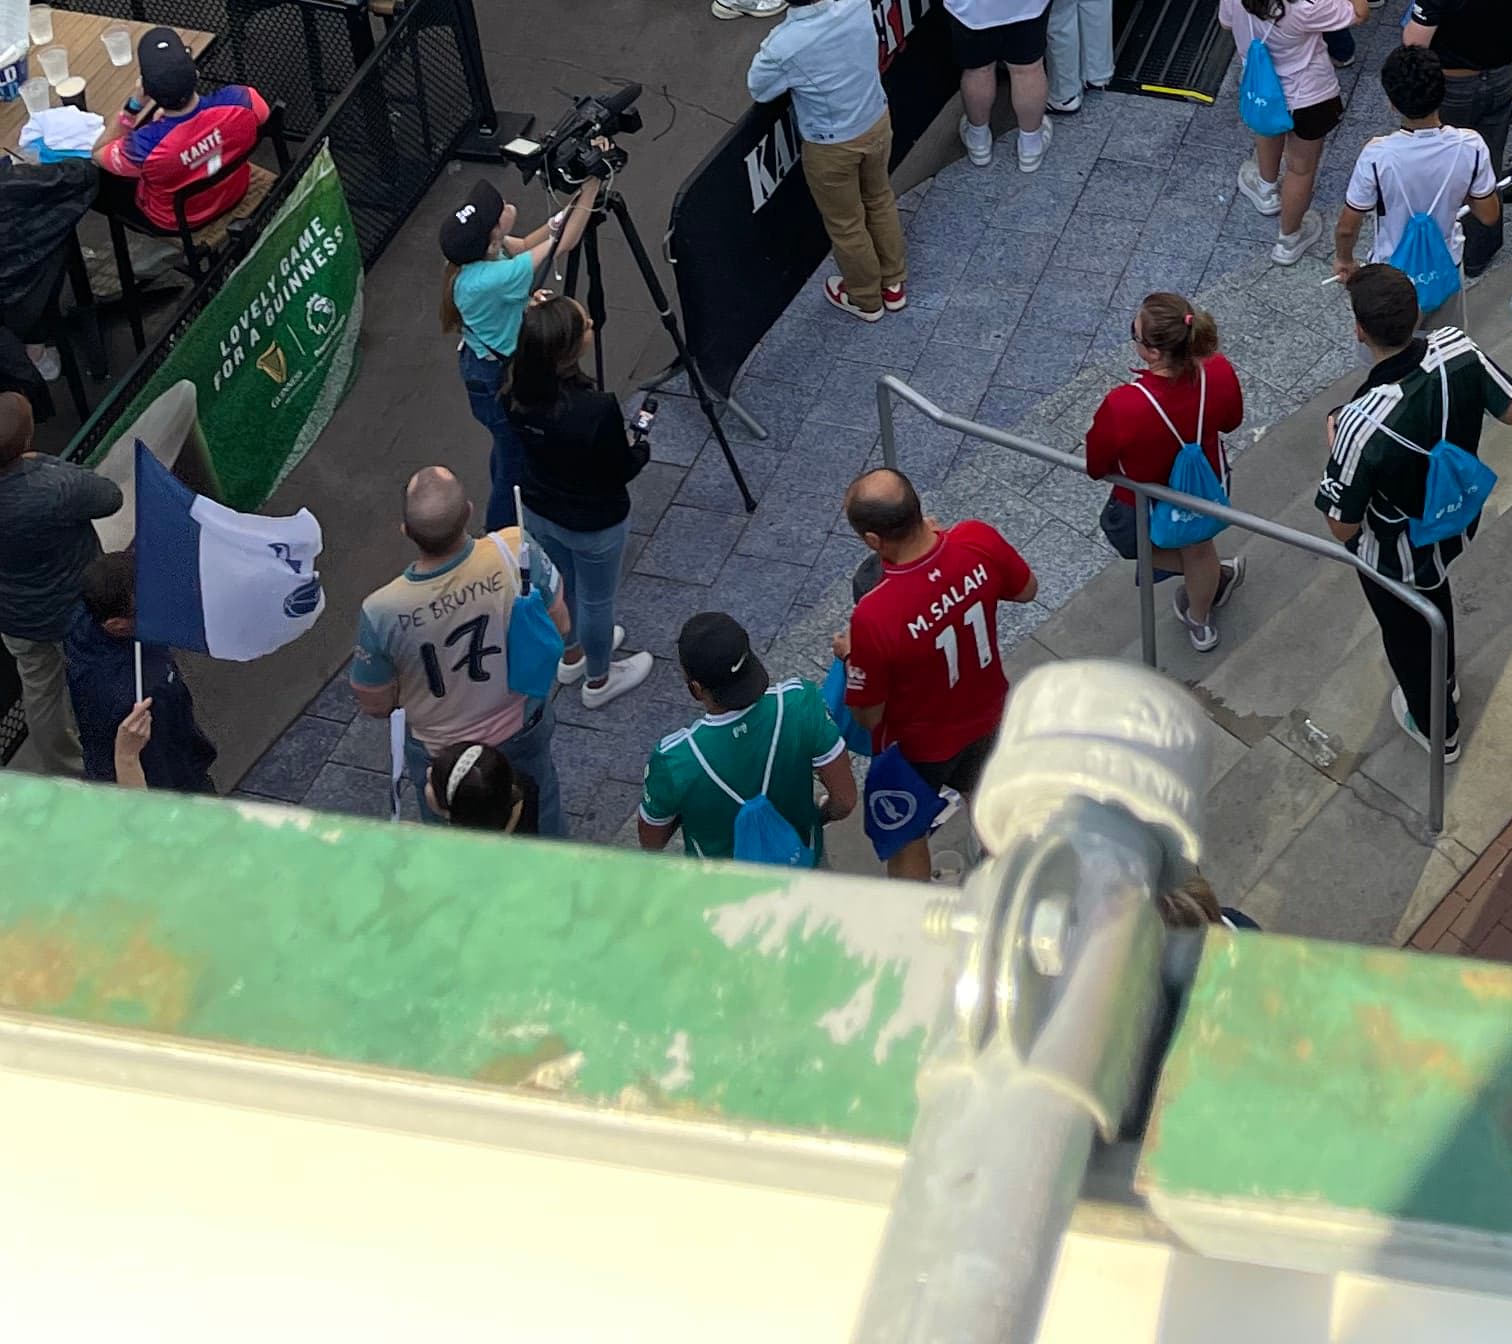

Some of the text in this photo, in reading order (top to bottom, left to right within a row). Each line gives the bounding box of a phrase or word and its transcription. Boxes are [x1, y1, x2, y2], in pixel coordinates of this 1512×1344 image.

[213, 345, 246, 392] FOR
[250, 327, 261, 348] A
[265, 224, 344, 327] GUINNESS
[219, 215, 326, 358] LOVELY GAME
[398, 571, 505, 632] DE BRUYNE
[907, 563, 989, 639] M.SALAH
[420, 614, 502, 698] 17
[935, 600, 993, 689] 11
